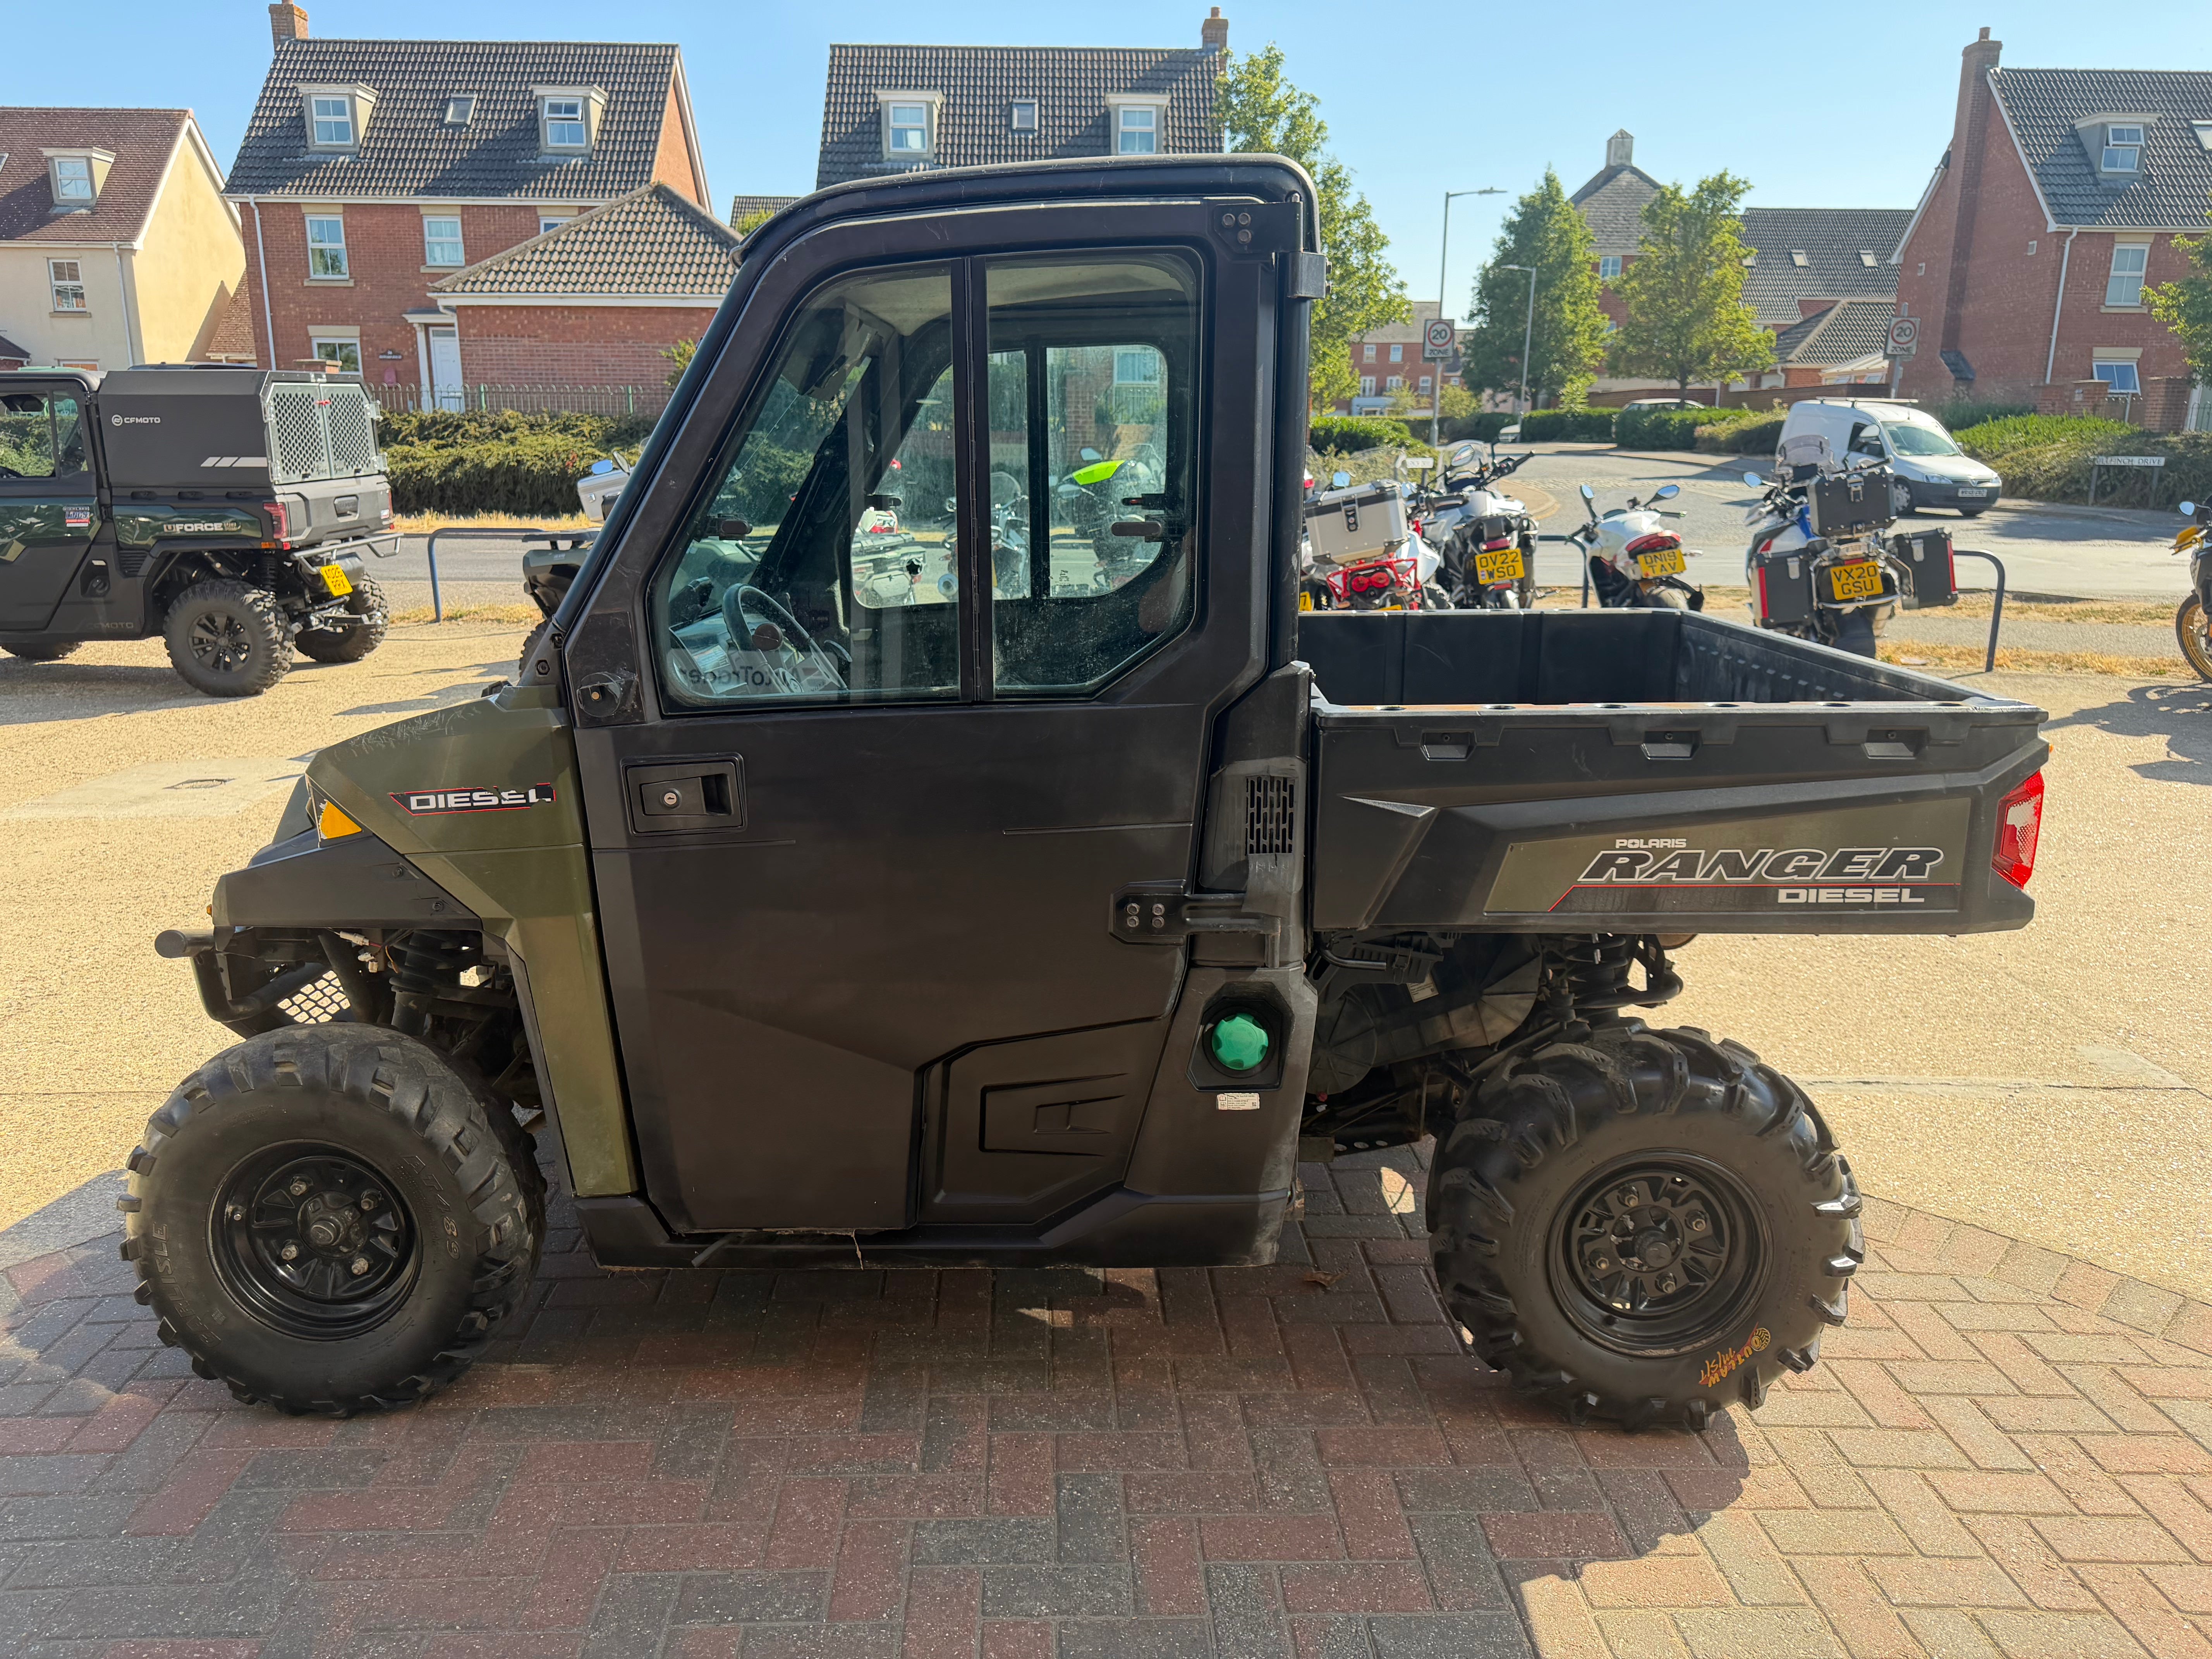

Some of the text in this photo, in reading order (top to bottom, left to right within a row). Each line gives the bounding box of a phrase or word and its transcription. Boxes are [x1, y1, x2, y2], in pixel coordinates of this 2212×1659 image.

[1432, 329, 1448, 340] 20
[1896, 326, 1912, 337] 20
[1479, 551, 1520, 568] OV22
[1644, 551, 1677, 565] DN19
[1486, 565, 1516, 580] WSO
[1648, 562, 1676, 574] TAV
[1833, 565, 1877, 582] VX20
[1841, 579, 1874, 595] GSU
[410, 788, 551, 810] DIESEL
[1616, 838, 1686, 848] POLARIS
[1577, 847, 1945, 883] RANGER
[1778, 888, 1925, 903] DIESEL
[153, 1221, 223, 1348] CARLISLE
[1708, 1336, 1761, 1388] OUTLAW
